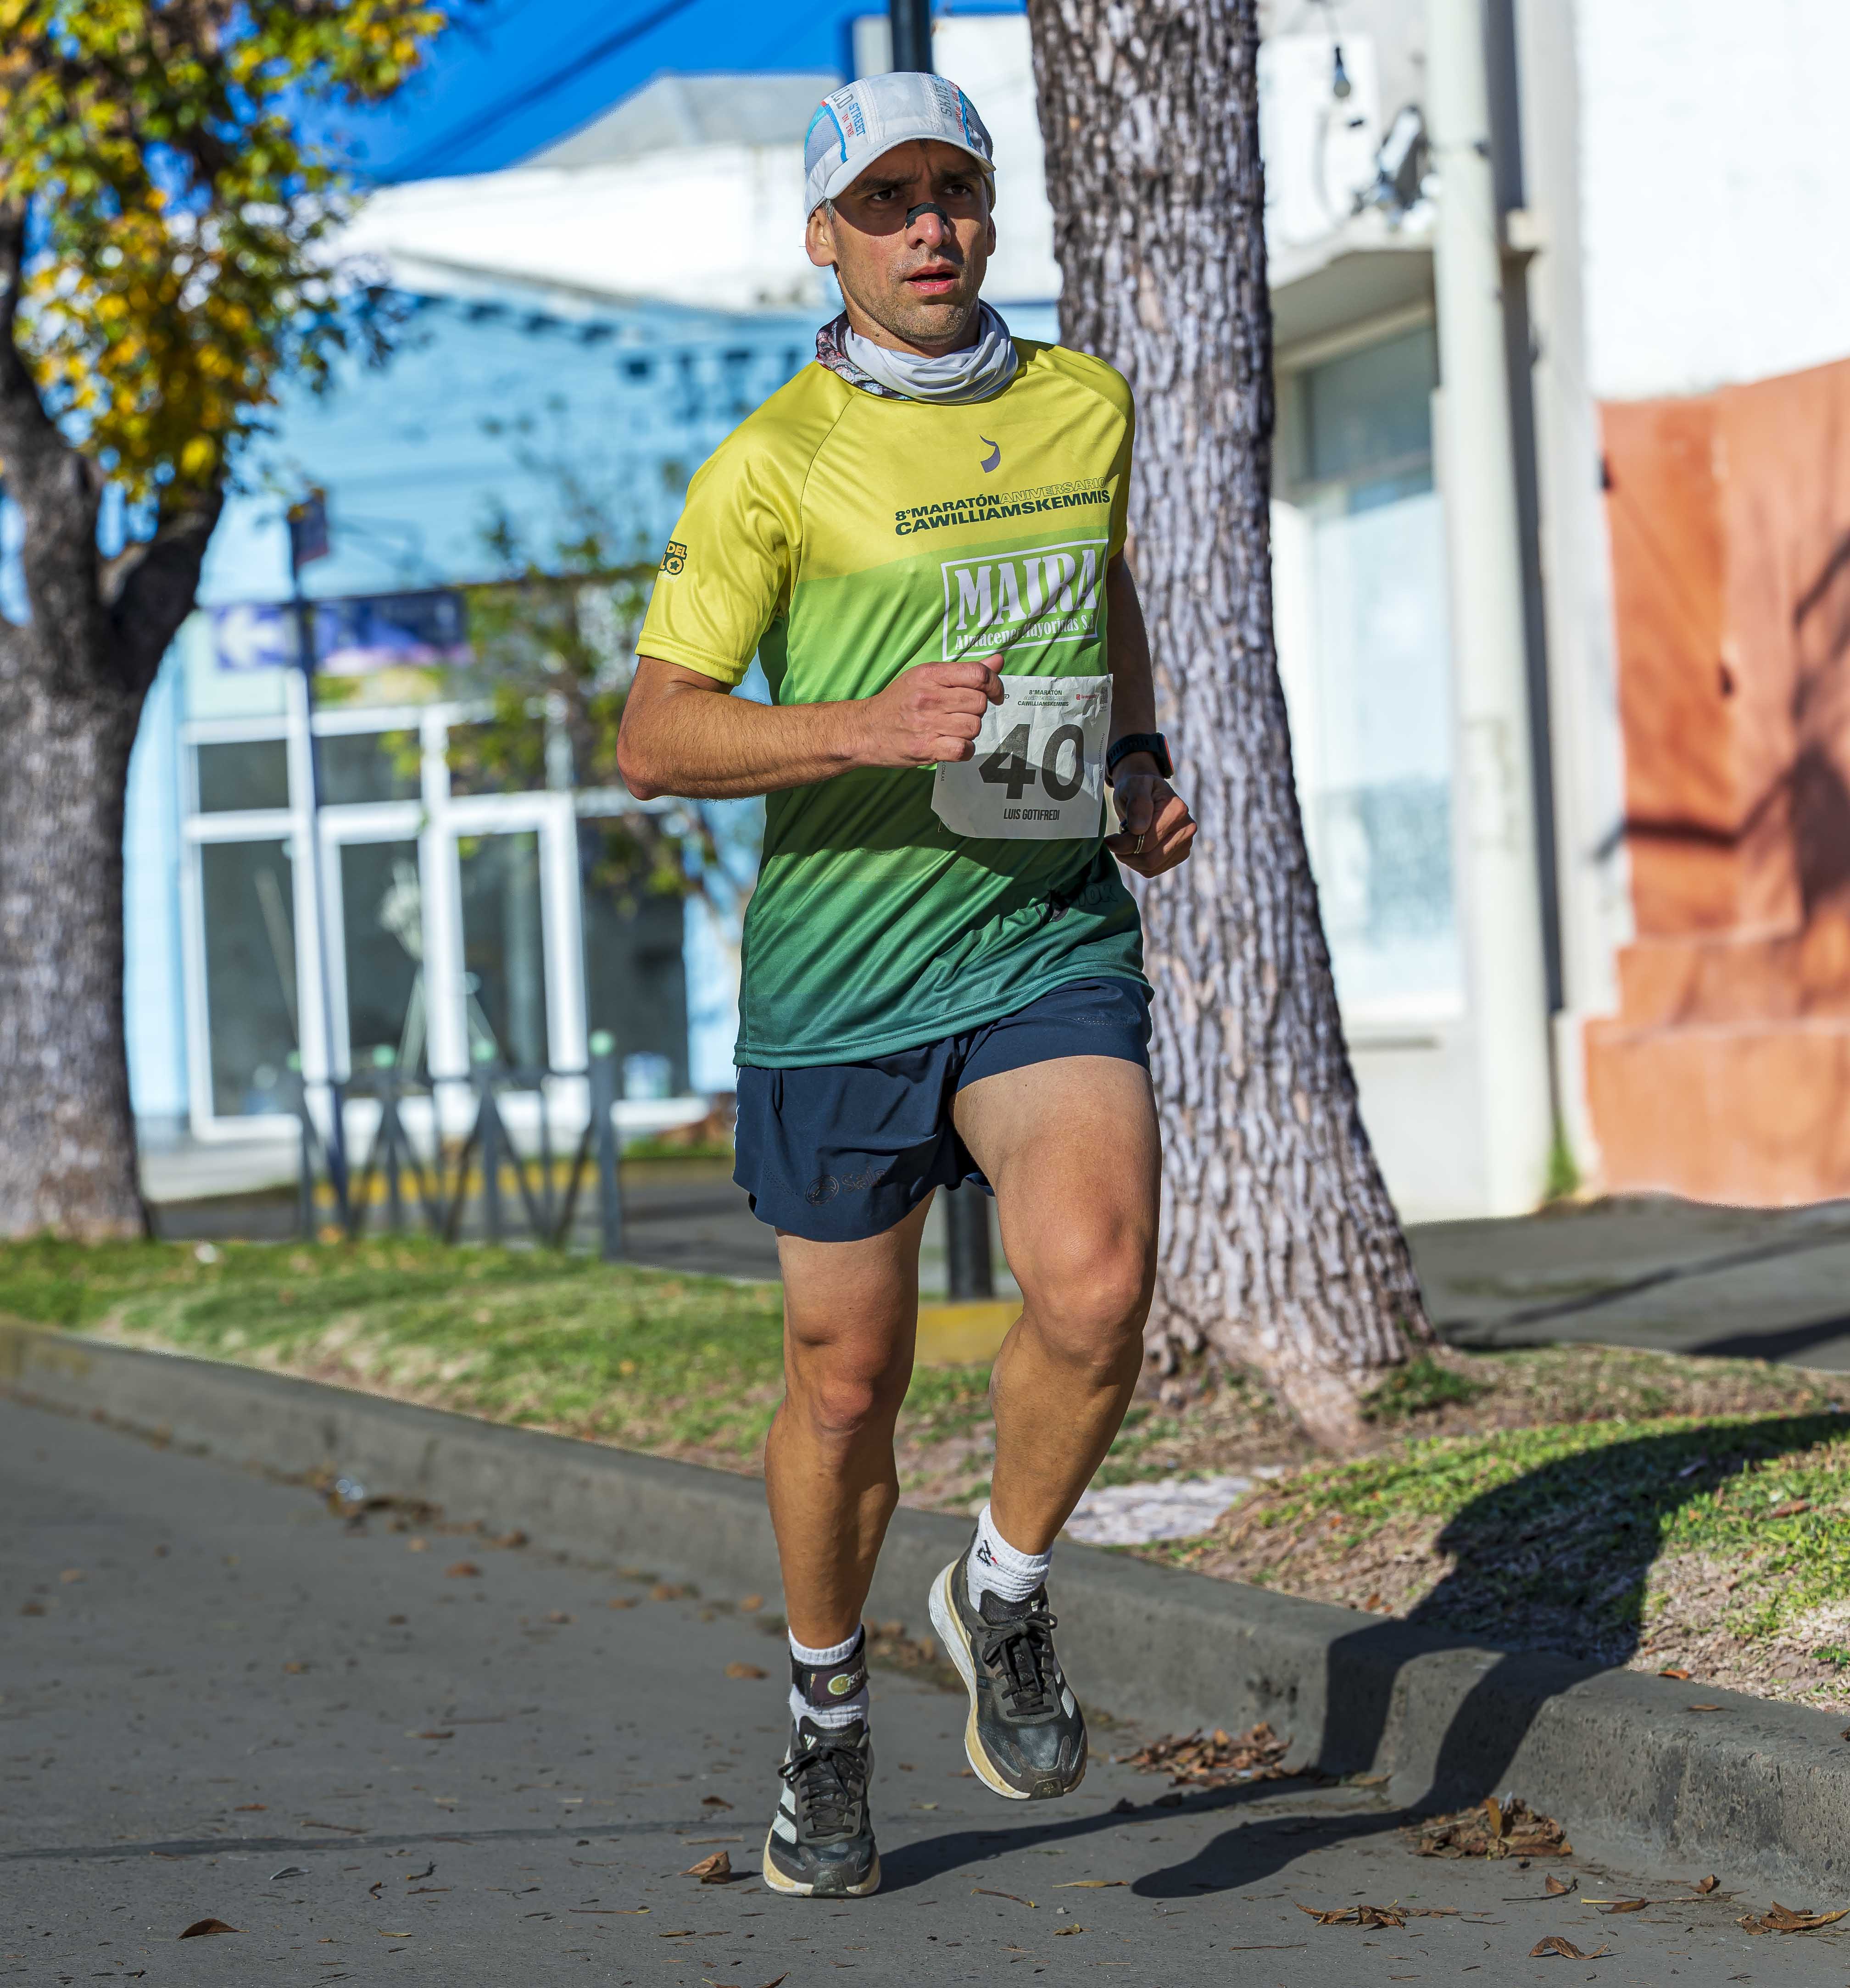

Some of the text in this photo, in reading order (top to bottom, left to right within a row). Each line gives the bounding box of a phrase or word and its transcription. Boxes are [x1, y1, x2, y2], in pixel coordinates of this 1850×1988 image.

[934, 83, 952, 117] SKATE
[842, 114, 854, 138] IN THE
[849, 102, 866, 136] STREET
[895, 490, 1110, 536] CAWILLIAMSKEMMIS
[666, 543, 686, 558] DEL
[954, 549, 1097, 630] MAIRA
[955, 627, 1020, 650] Almacenes
[1022, 618, 1079, 639] Mayoristas
[979, 723, 1085, 802] 40
[1003, 808, 1060, 821] LUIS GOTIFREDI
